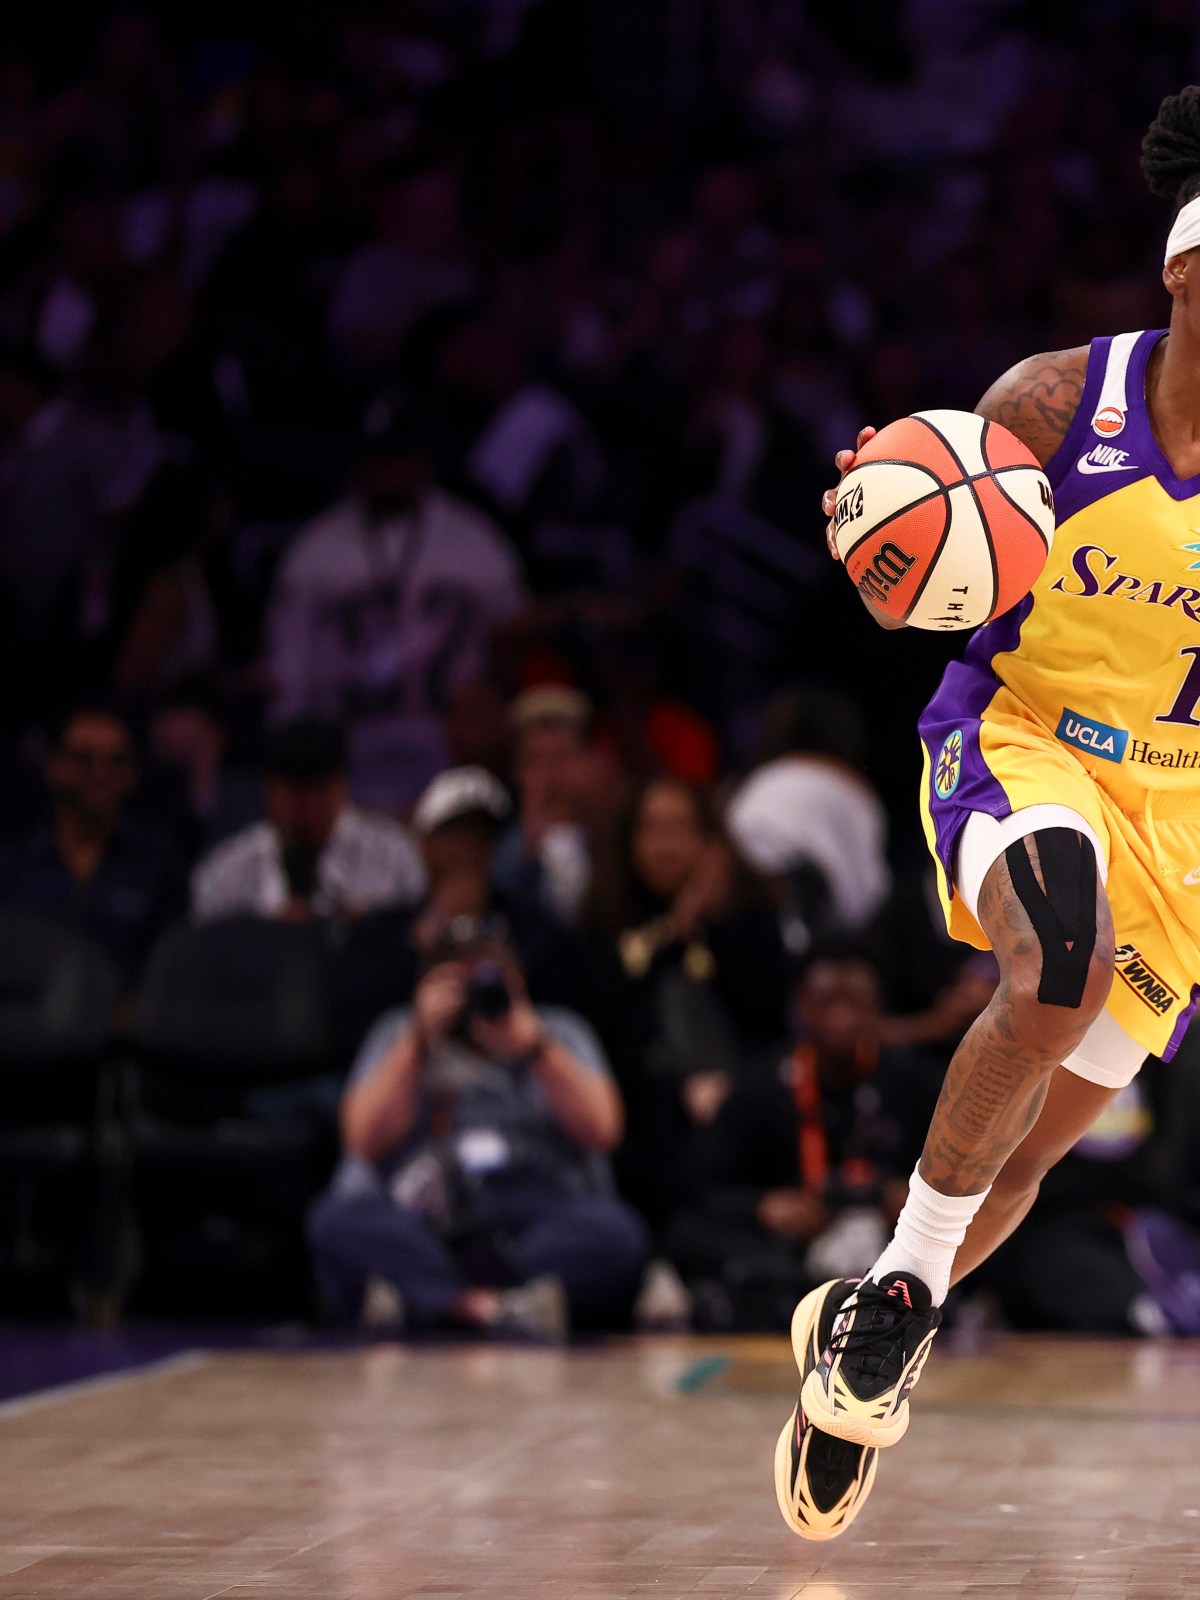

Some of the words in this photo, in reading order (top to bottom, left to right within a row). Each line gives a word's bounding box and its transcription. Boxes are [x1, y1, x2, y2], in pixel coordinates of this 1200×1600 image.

[1088, 443, 1131, 467] NIKE
[1065, 718, 1115, 754] UCLA
[1122, 960, 1175, 1014] WNBA
